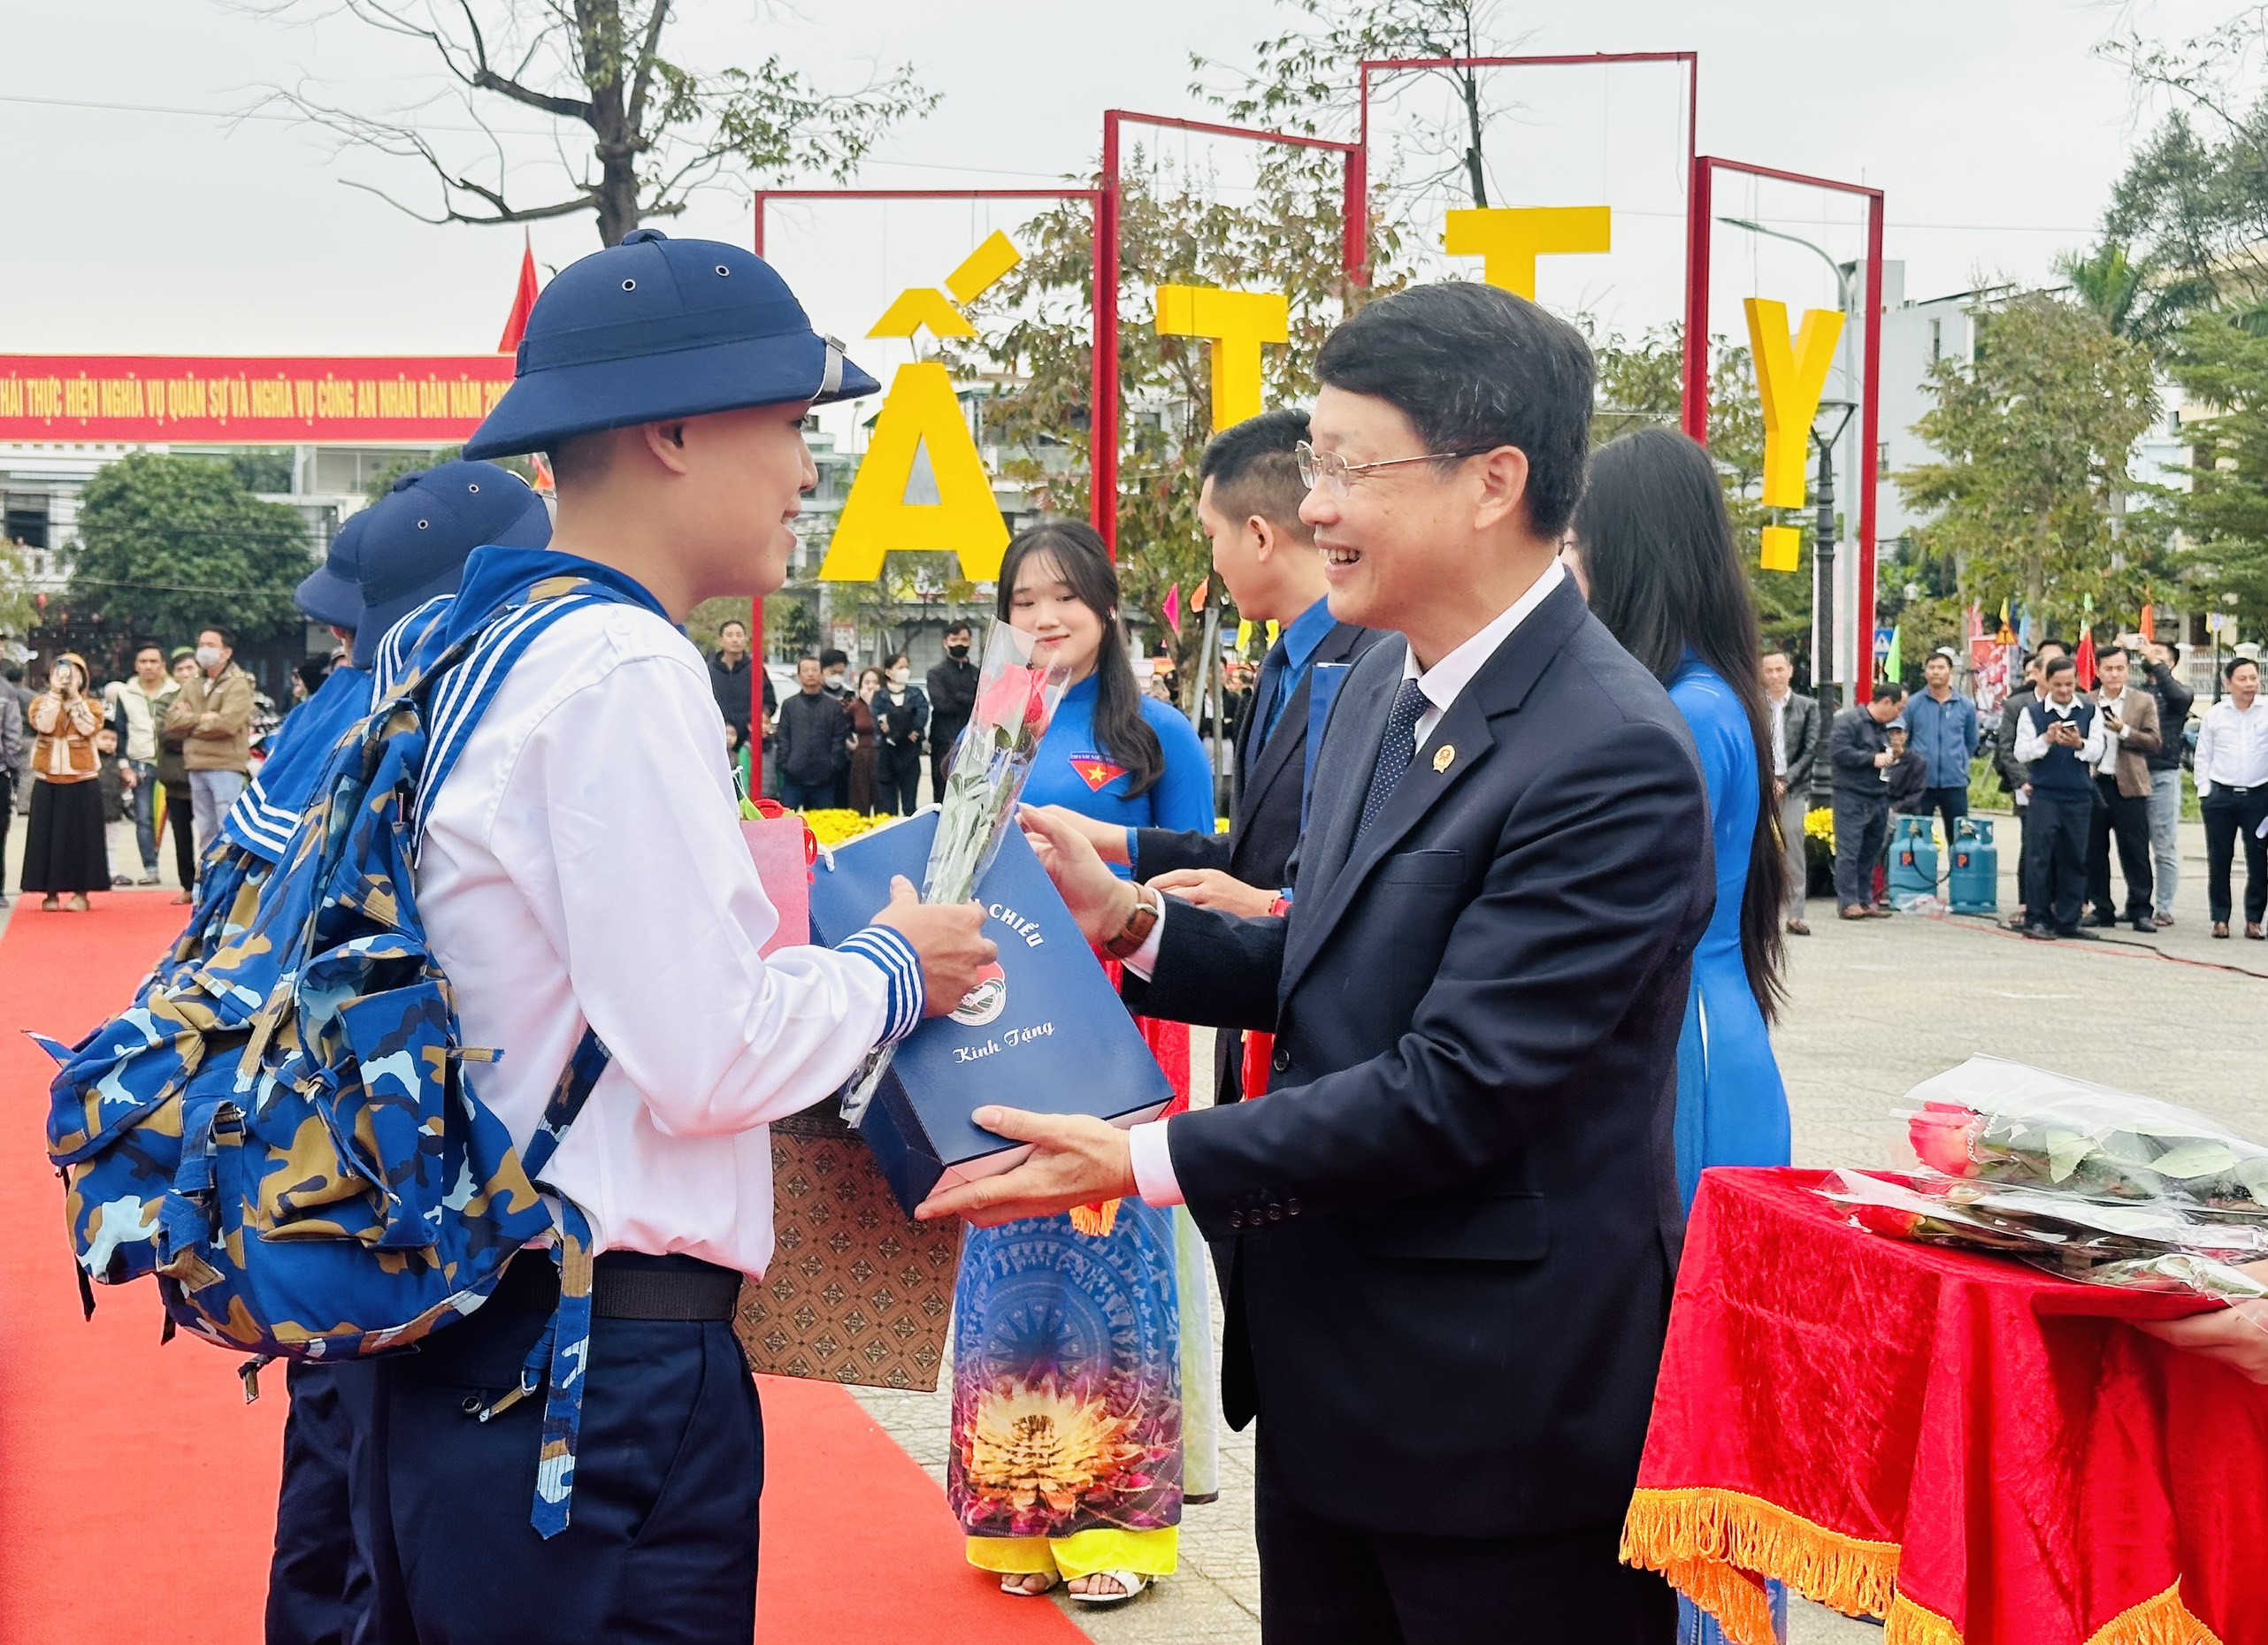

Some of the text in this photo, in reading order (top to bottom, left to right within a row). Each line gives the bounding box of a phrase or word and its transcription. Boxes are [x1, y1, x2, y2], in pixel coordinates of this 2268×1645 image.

[27, 375, 62, 426] THỰC
[65, 371, 98, 426] HIỆN
[101, 371, 144, 418] NGHĨA
[146, 379, 165, 426] VỤ
[168, 371, 206, 423] QUÂN
[209, 375, 229, 426] SỰ
[230, 371, 249, 418] VÀ
[250, 372, 295, 418] NGHĨA
[295, 379, 314, 426] VỤ
[317, 371, 353, 418] CÔNG
[356, 380, 377, 418] AN
[379, 372, 418, 418] NHÂN
[419, 372, 448, 418] DÂN
[450, 373, 481, 418] NĂM
[1003, 1021, 1055, 1047] Tặng
